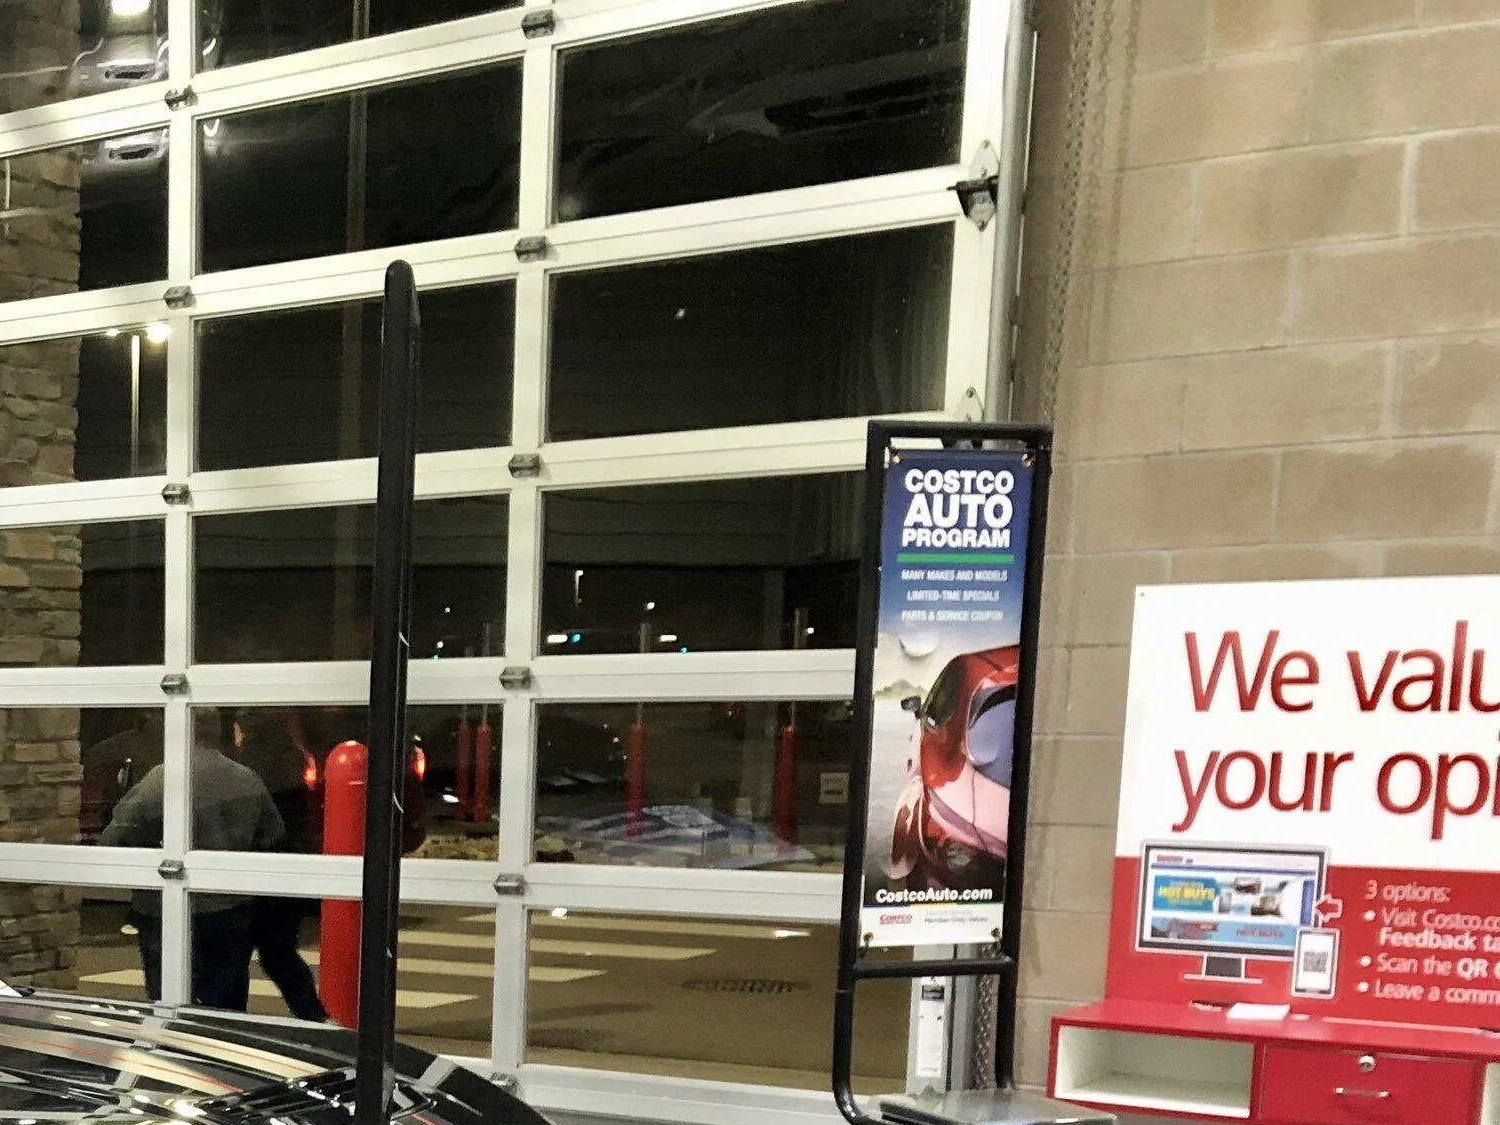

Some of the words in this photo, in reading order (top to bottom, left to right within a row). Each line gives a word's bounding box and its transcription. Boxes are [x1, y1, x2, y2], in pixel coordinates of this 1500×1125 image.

[905, 469, 1015, 494] COSTCO
[903, 494, 1013, 527] AUTO
[902, 528, 1010, 548] PROGRAM
[902, 569, 926, 580] MANY
[927, 569, 955, 581] MAKES
[956, 570, 974, 580] AND
[975, 570, 1008, 582] MODELS
[963, 590, 1000, 601] SPECIALS
[1185, 630, 1319, 712] We
[1347, 620, 1500, 712] valu
[1172, 750, 1354, 832] your
[876, 887, 993, 903] CostcoAuto.com
[1365, 880, 1378, 900] 3
[1383, 881, 1452, 904] options:
[1381, 907, 1418, 928] Visit
[1379, 926, 1476, 951] Feedback
[1376, 952, 1418, 973] Scan
[1423, 954, 1452, 976] the
[1457, 957, 1488, 980] QR
[1374, 979, 1424, 1001] Leave
[1428, 985, 1441, 1002] a
